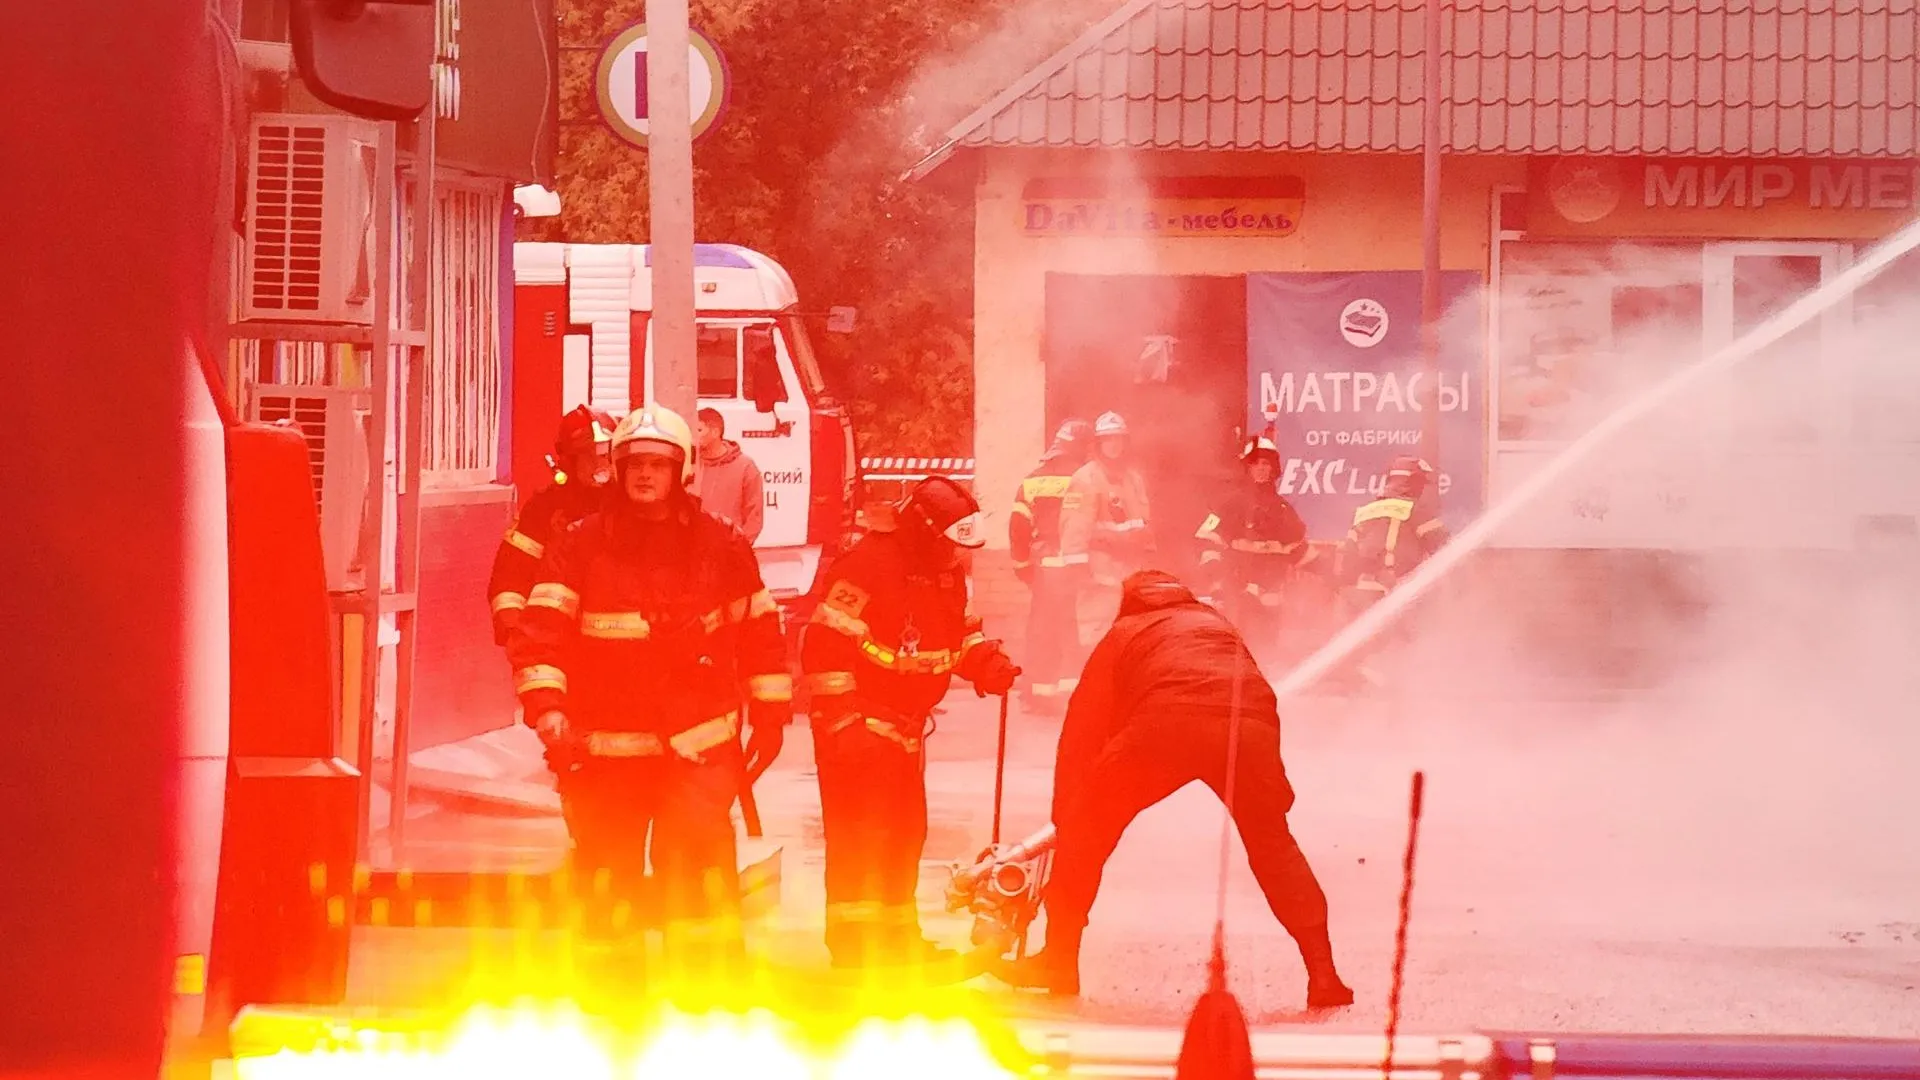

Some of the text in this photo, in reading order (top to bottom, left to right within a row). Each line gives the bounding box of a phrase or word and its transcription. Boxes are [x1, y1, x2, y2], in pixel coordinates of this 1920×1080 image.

[1644, 165, 1794, 207] МИР
[1261, 371, 1469, 413] МАТРАСЫ
[1306, 429, 1422, 446] ОТ ФАБРИКИ
[835, 588, 858, 608] 22
